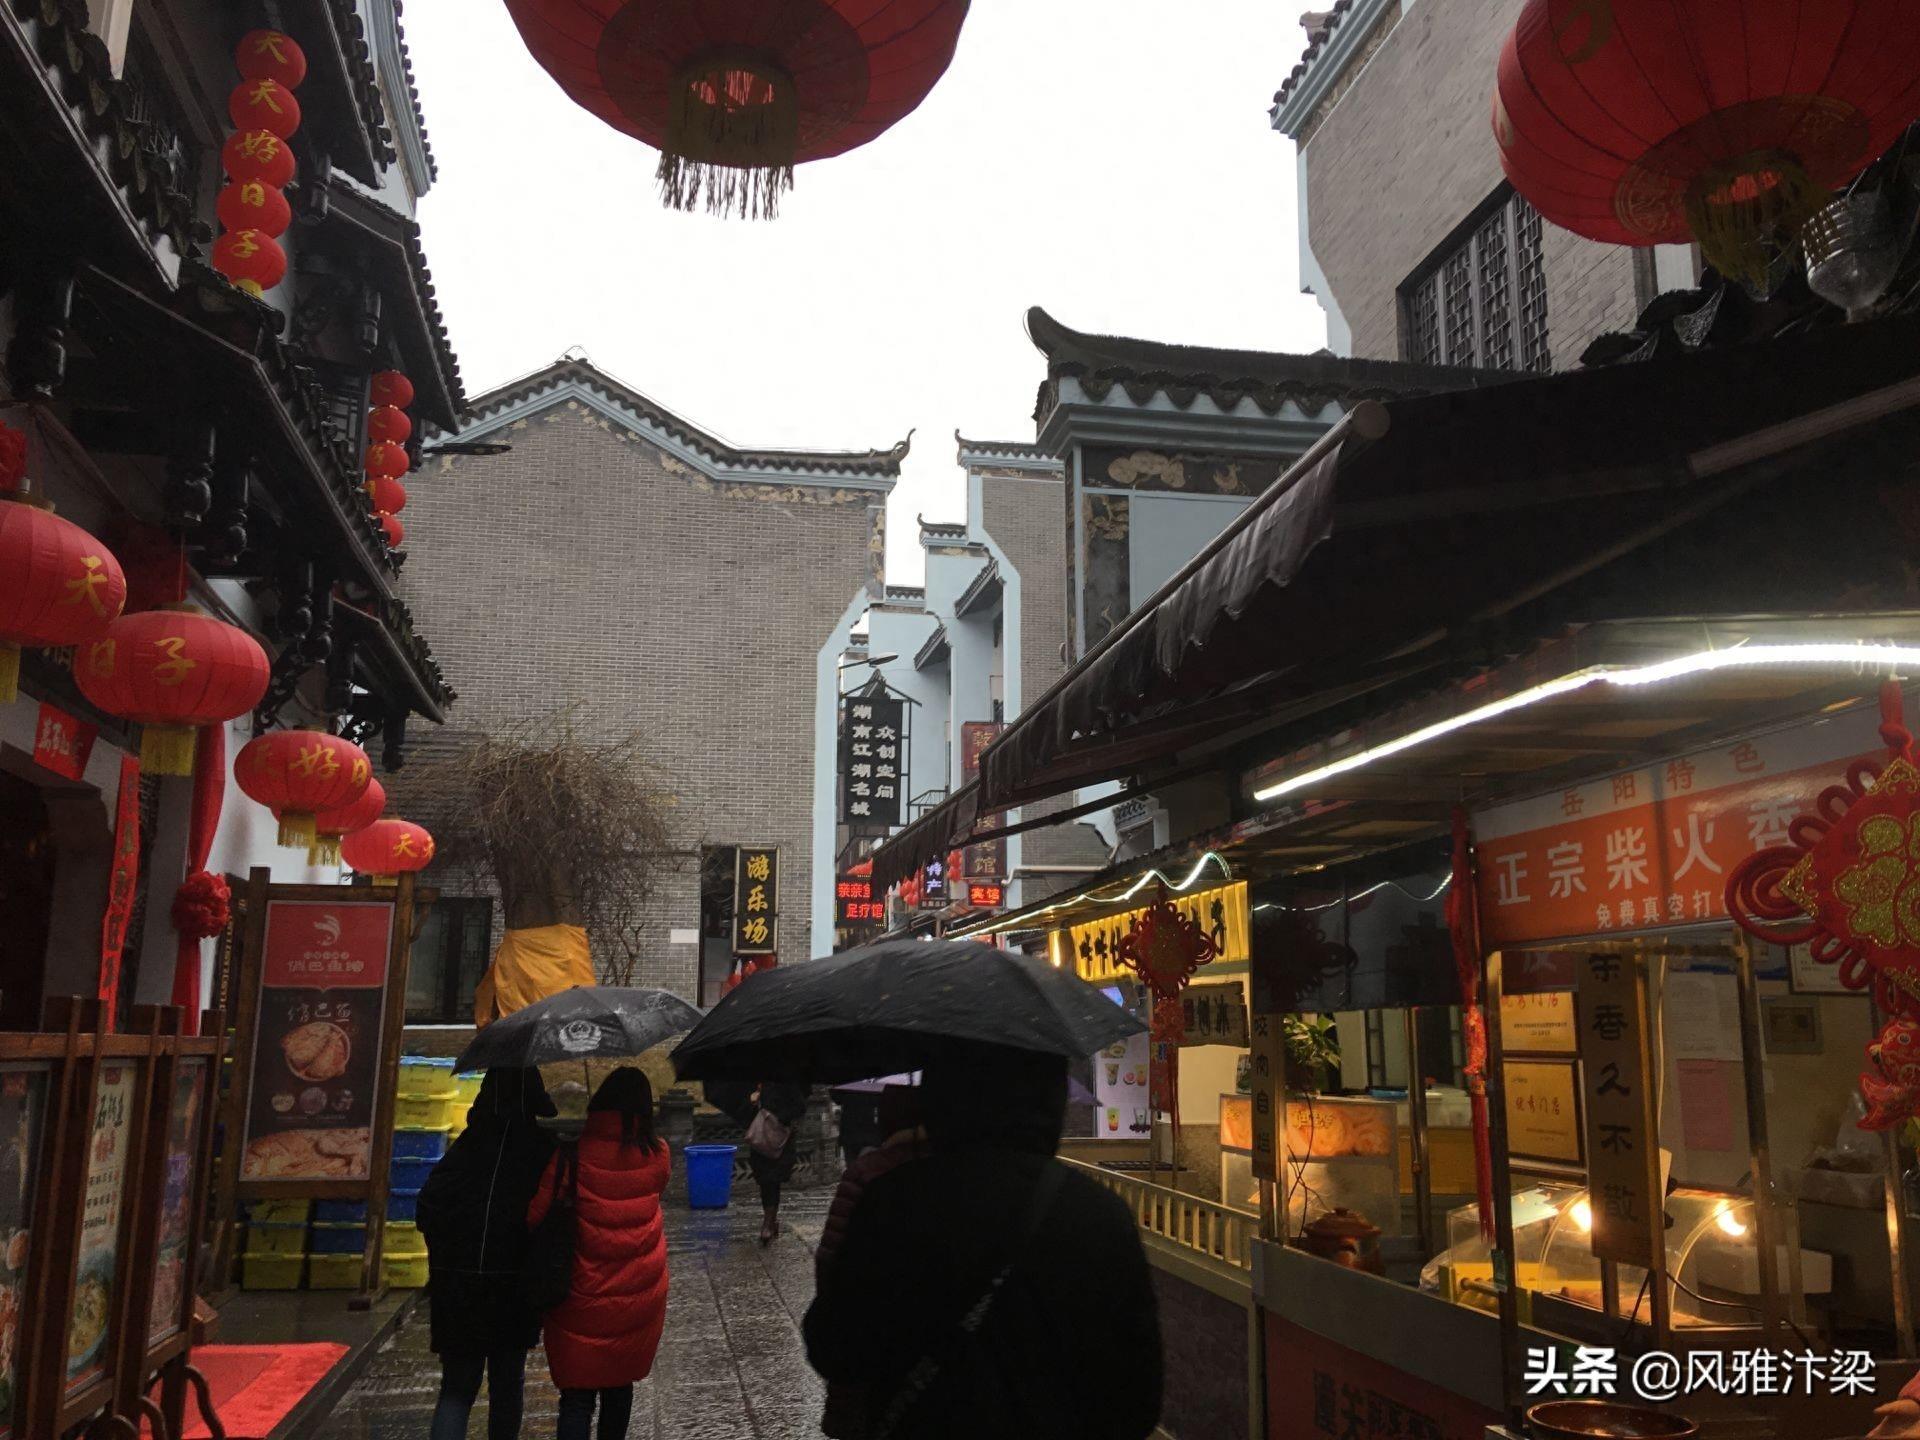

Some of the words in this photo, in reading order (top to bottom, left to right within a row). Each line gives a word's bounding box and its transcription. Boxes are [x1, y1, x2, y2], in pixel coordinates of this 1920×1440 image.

[850, 704, 873, 817] 湖南江湖名城
[875, 725, 897, 800] 众创空间
[1560, 743, 1765, 817] 岳阳特色
[742, 853, 770, 945] 游乐场
[846, 903, 884, 918] 足疗馆
[970, 886, 1000, 902] 宾馆
[1596, 889, 1730, 930] 免费真空打
